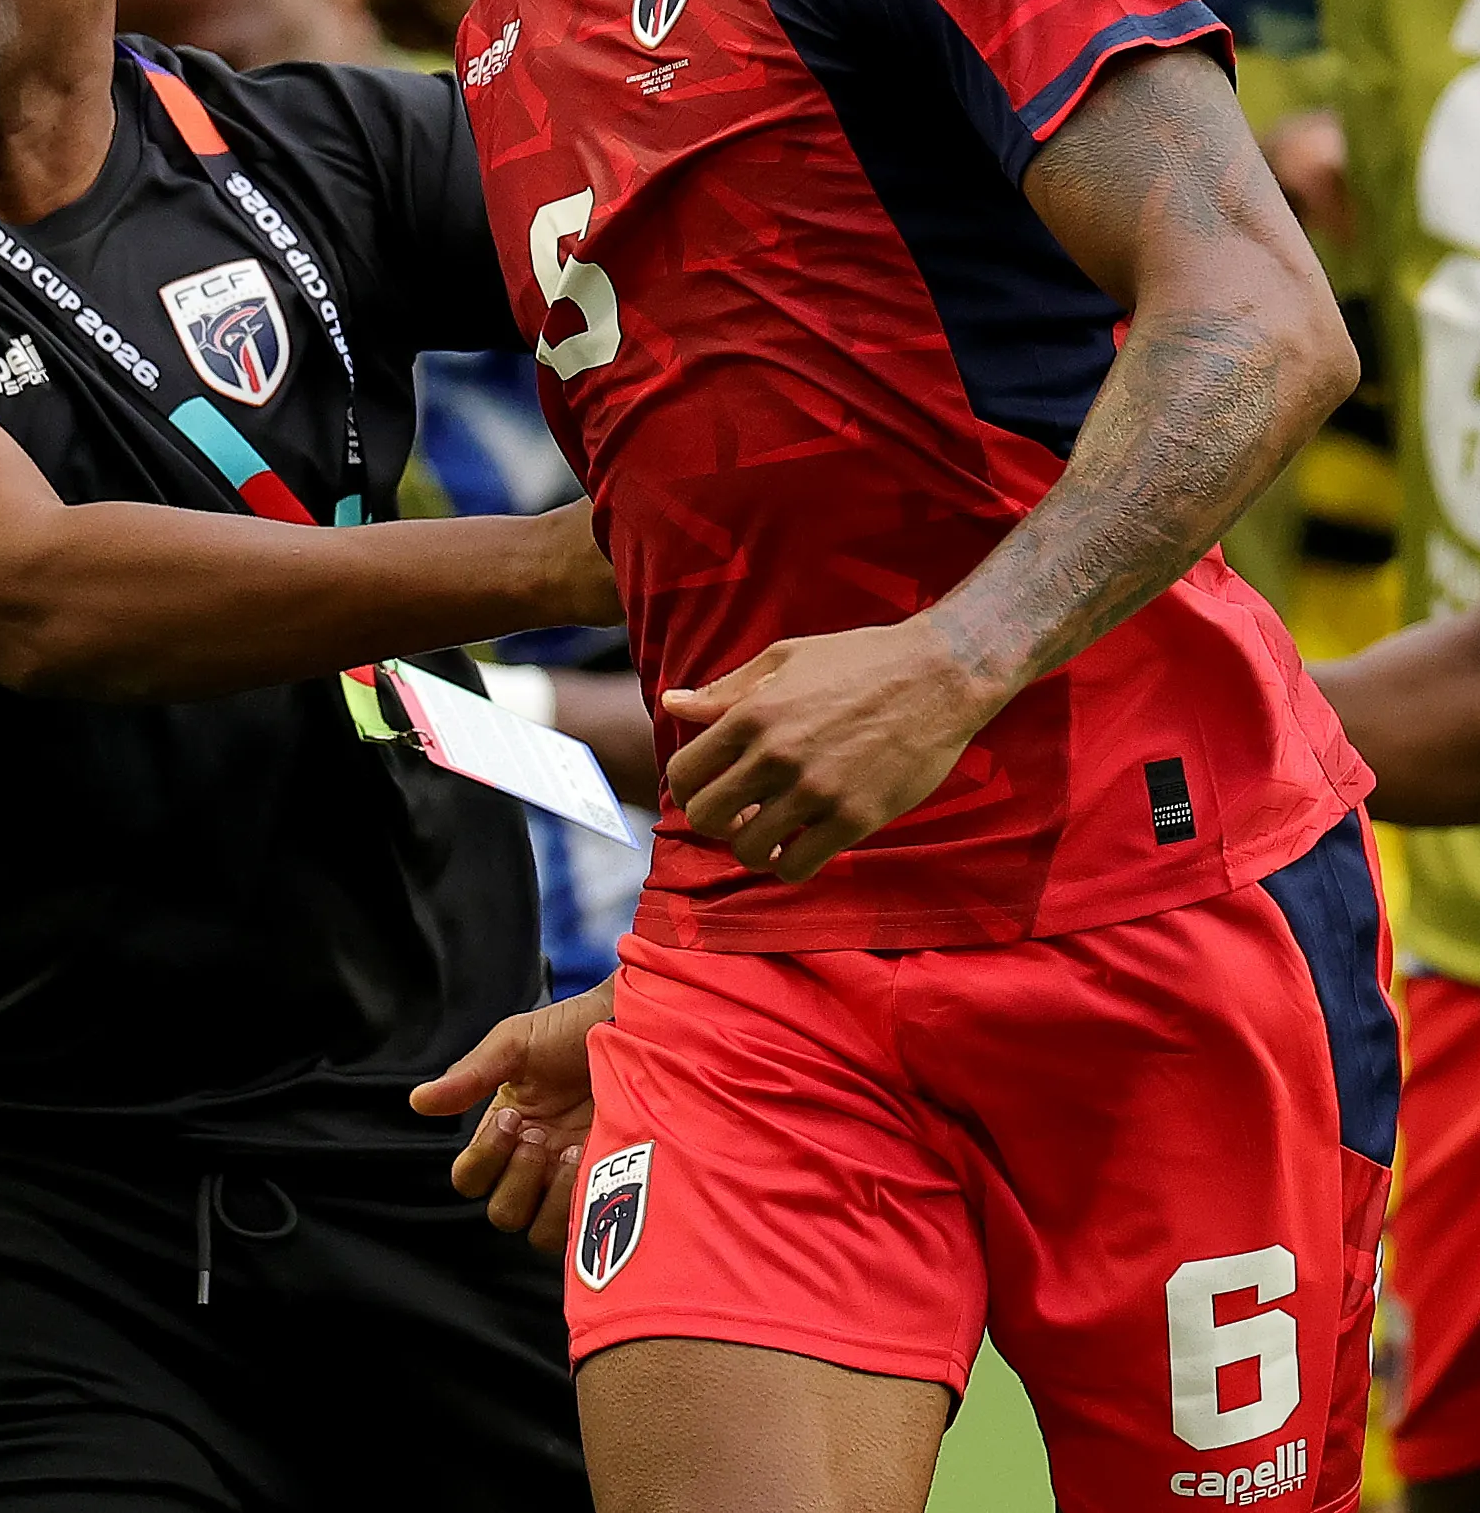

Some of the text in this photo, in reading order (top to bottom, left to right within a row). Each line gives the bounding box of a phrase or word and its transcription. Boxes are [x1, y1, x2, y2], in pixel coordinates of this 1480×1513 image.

[463, 18, 521, 90] apelli
[31, 265, 83, 312] CUP
[174, 269, 252, 310] FCF
[285, 248, 329, 300] CUP
[320, 299, 355, 391] ORLD
[592, 1150, 647, 1188] FCF
[1165, 1243, 1301, 1451] 6
[1170, 1438, 1307, 1506] capelli
[1238, 1475, 1307, 1507] SPORT
